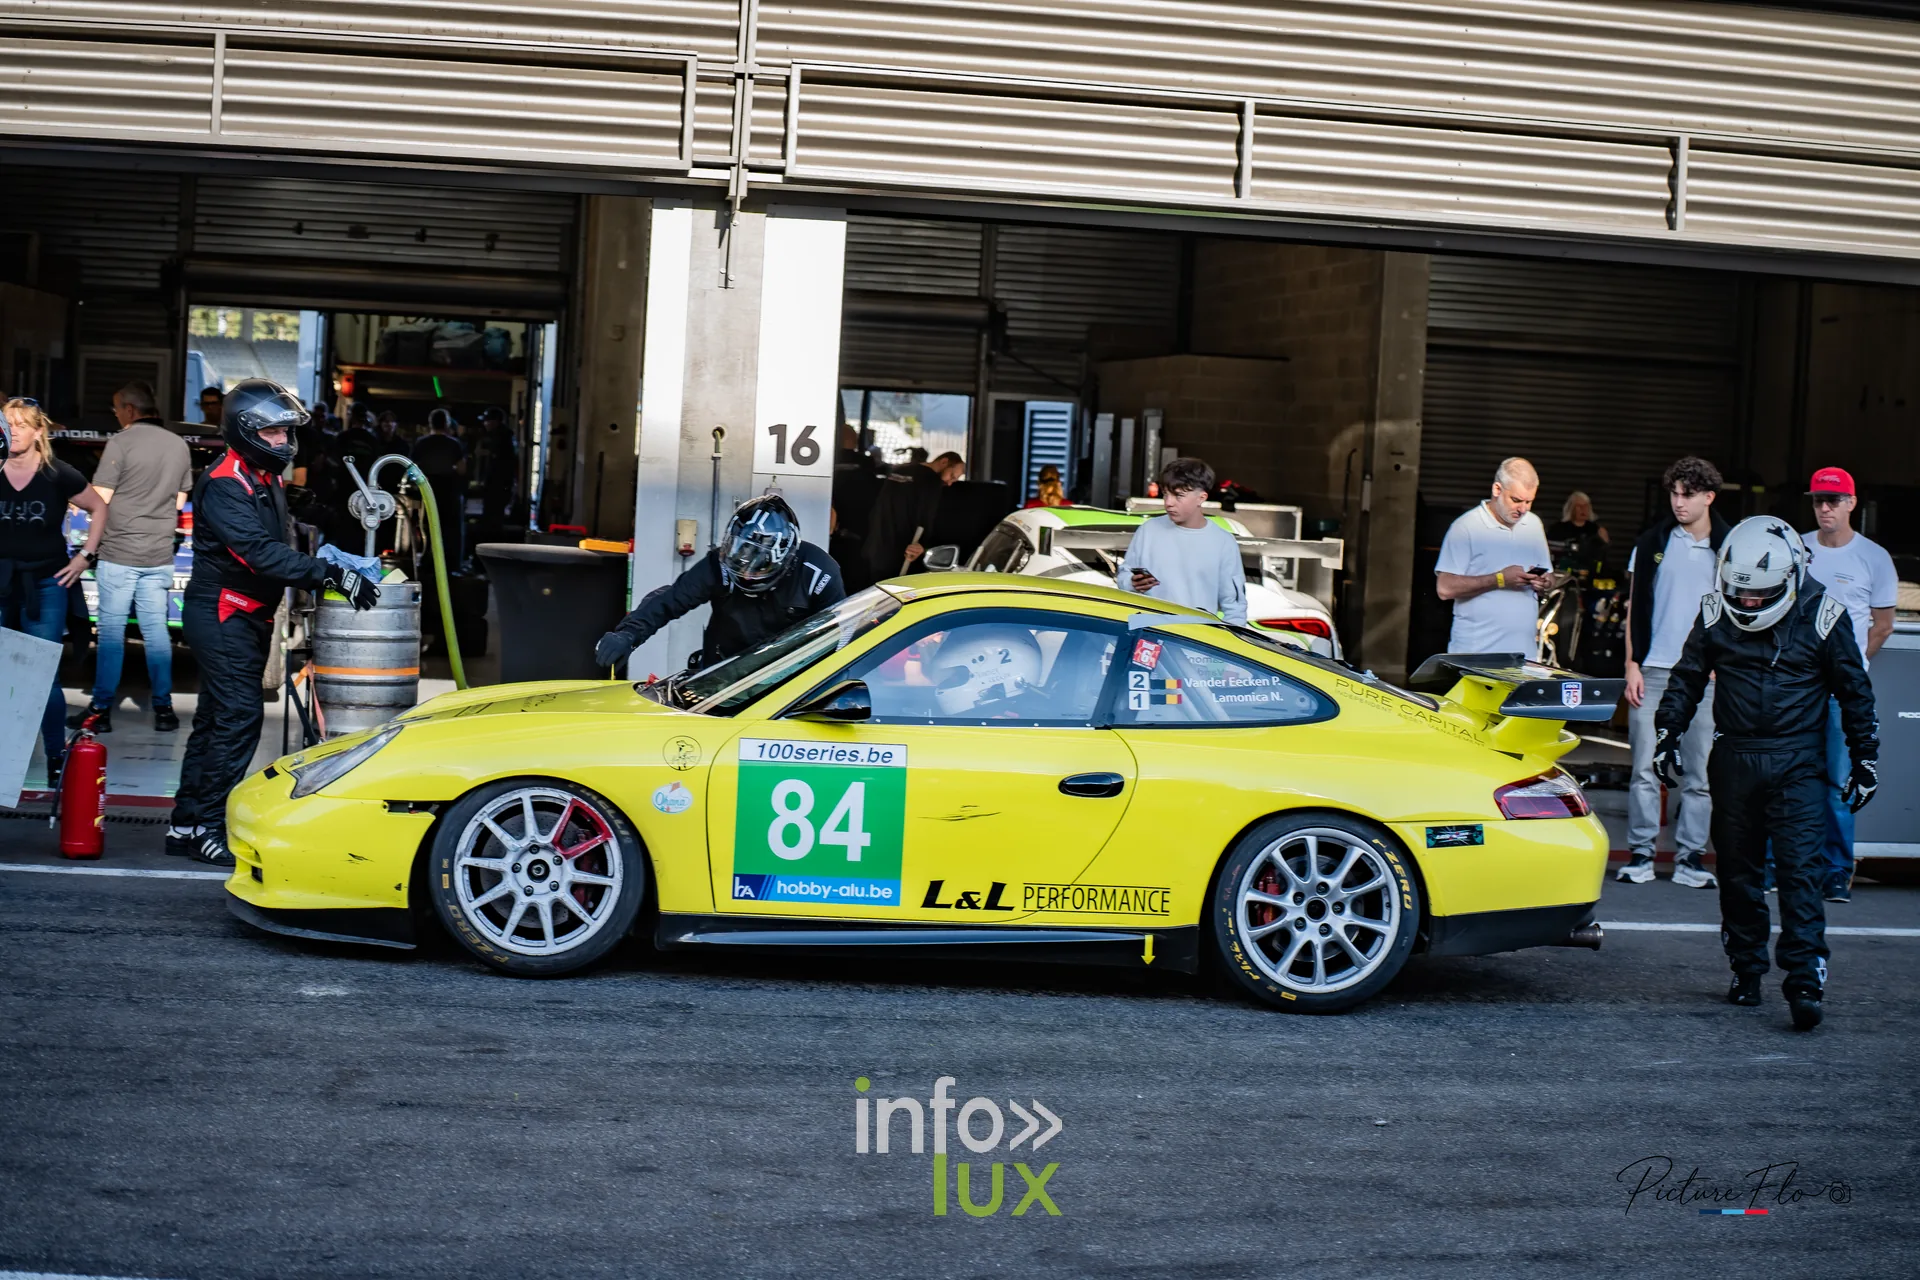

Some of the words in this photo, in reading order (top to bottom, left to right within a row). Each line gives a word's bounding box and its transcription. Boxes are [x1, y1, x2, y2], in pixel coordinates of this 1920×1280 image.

[768, 424, 820, 466] 16
[998, 649, 1012, 664] 2
[1133, 674, 1145, 688] 2
[1184, 677, 1228, 688] Vander
[1229, 677, 1270, 687] Eecken
[1272, 676, 1282, 687] P.
[1133, 693, 1142, 708] 1
[1213, 692, 1269, 703] Lamonica
[1271, 691, 1284, 702] N.
[1335, 678, 1393, 708] PURE
[1400, 704, 1485, 744] CAPITAL
[757, 743, 893, 763] 100series.be
[767, 779, 871, 862] 84
[776, 880, 893, 899] hobby-alu.be
[1384, 851, 1413, 911] ZERO
[920, 880, 1015, 911] L&L
[1022, 886, 1170, 913] PERFORMANCE
[448, 904, 495, 954] ZERO
